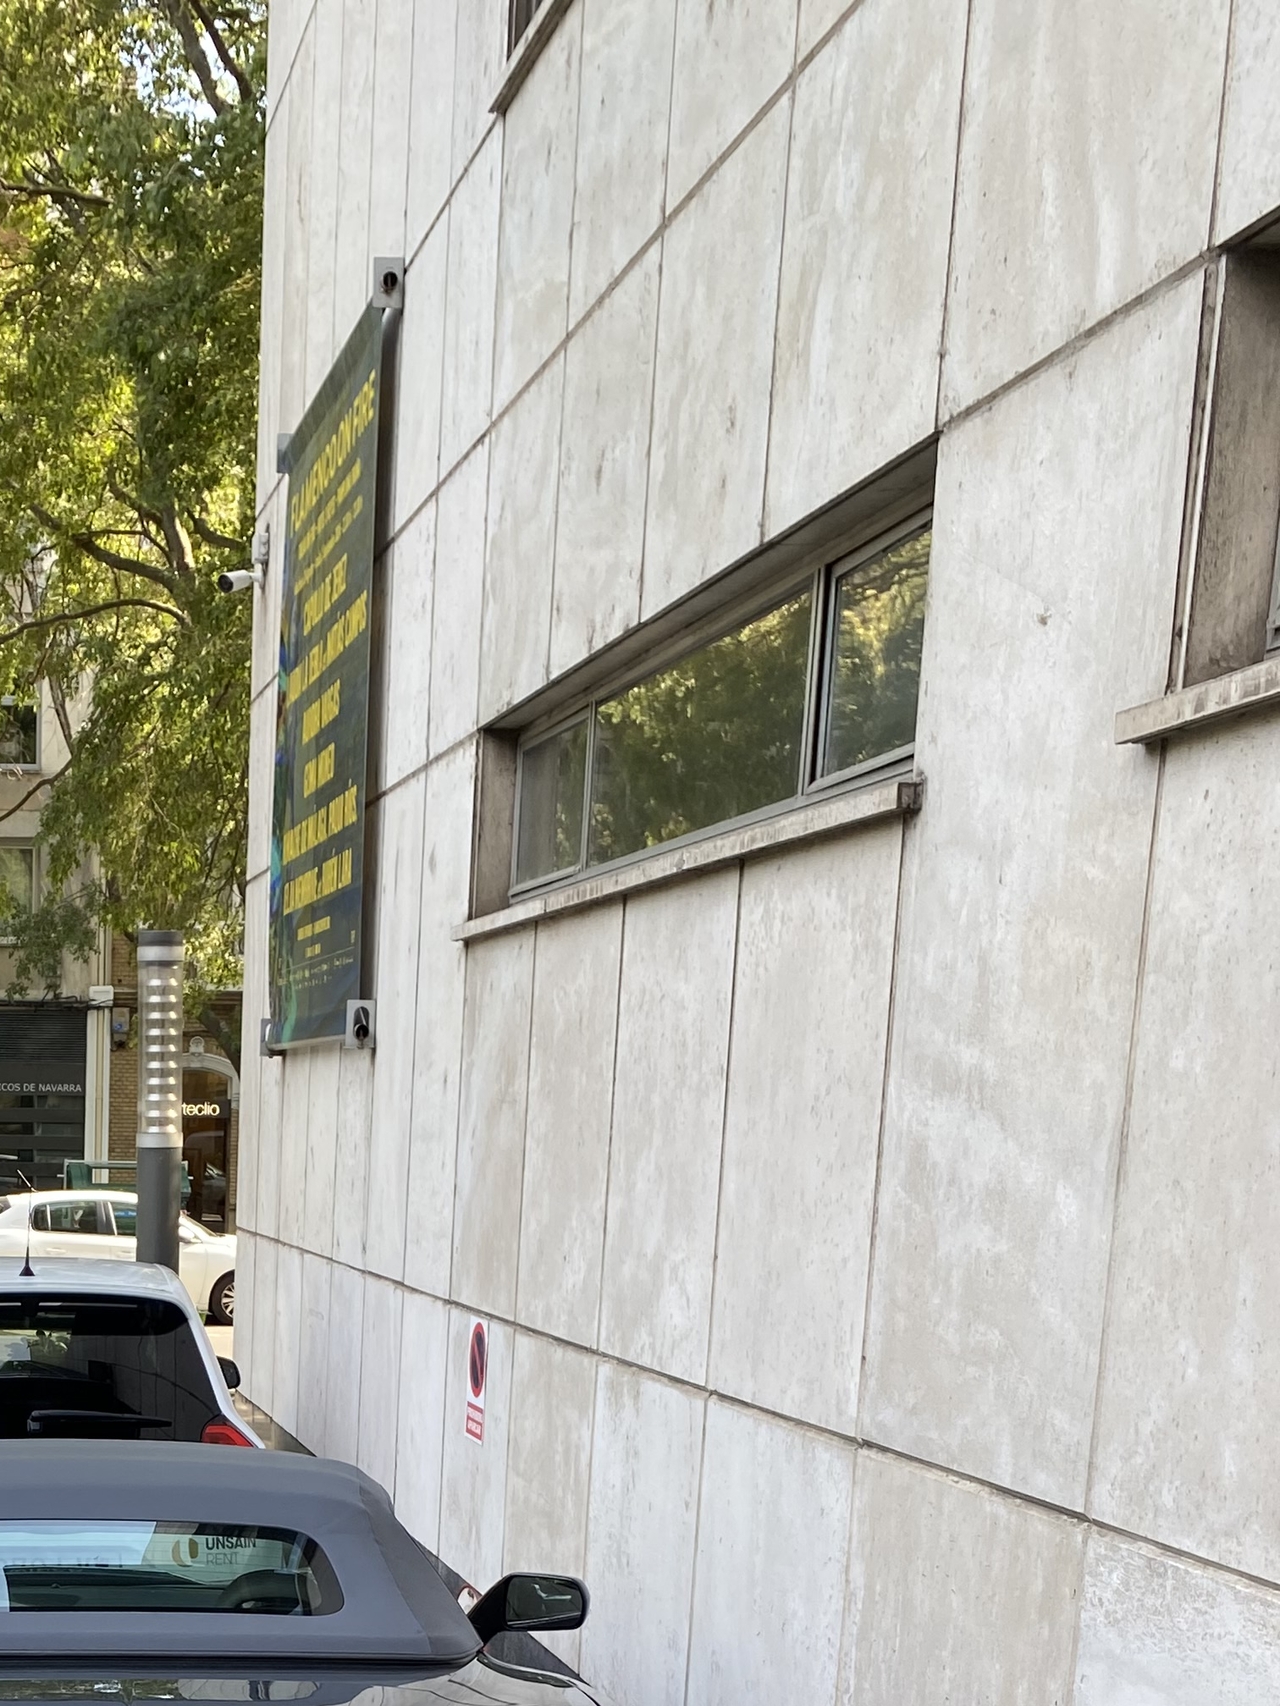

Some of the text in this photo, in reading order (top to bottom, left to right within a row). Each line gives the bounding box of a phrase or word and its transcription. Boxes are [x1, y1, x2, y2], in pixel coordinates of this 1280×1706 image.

[290, 434, 337, 538] FLAMENCO
[352, 369, 376, 447] FIRE
[23, 1082, 36, 1093] DE
[38, 1083, 82, 1093] NAVARRA
[206, 1552, 239, 1566] RENT
